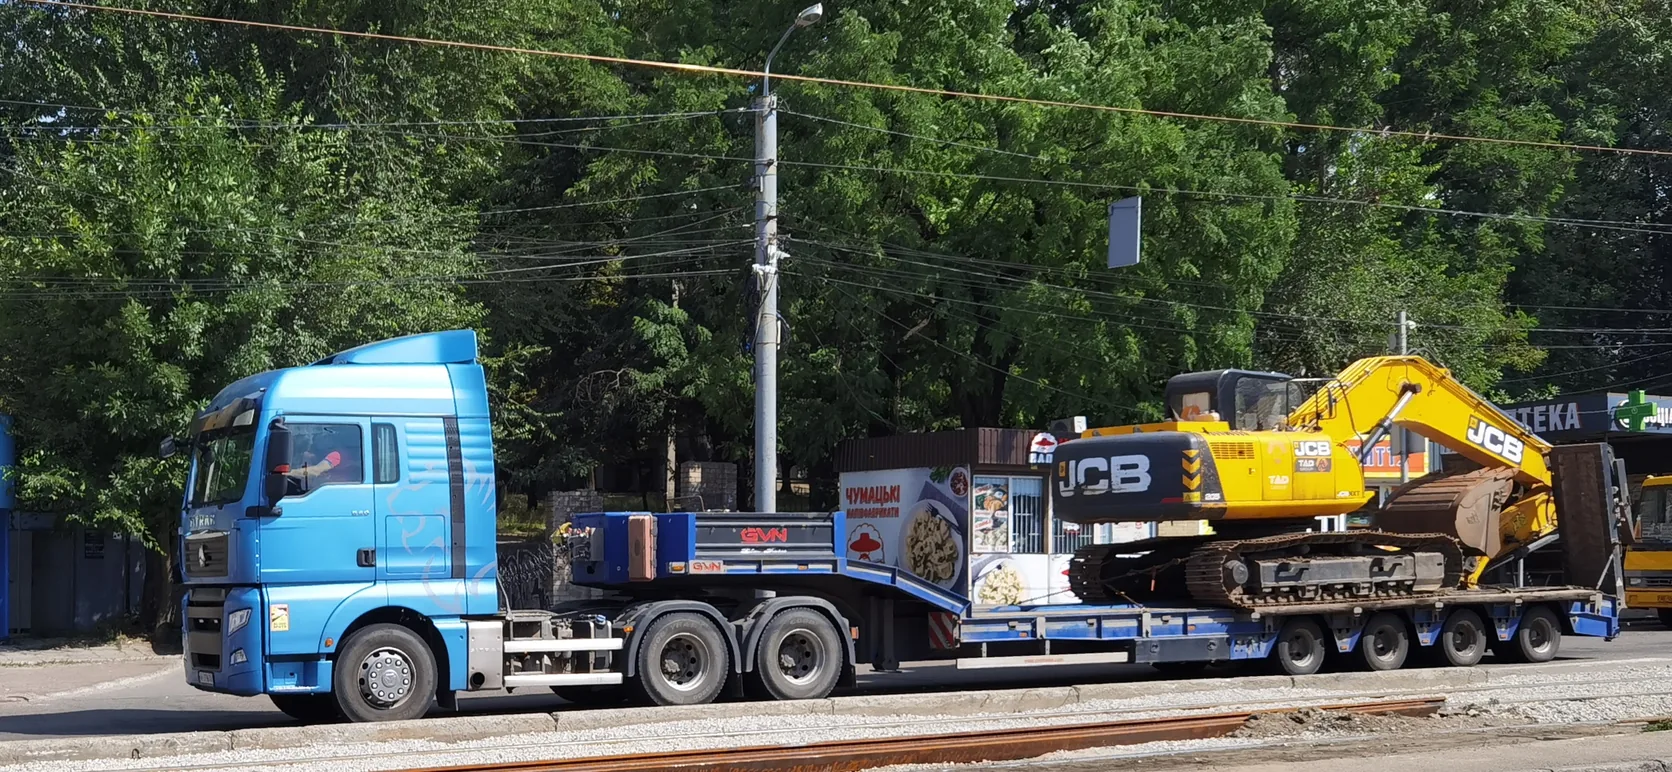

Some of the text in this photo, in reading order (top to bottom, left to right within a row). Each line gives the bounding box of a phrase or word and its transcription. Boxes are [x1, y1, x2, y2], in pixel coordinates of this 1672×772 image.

[1295, 441, 1331, 456] JCB
[1467, 421, 1524, 463] JCB
[1059, 454, 1151, 497] JCB
[845, 485, 900, 506] ЧУМАЦЬКІ
[741, 527, 788, 544] GVN
[693, 561, 721, 571] GVN
